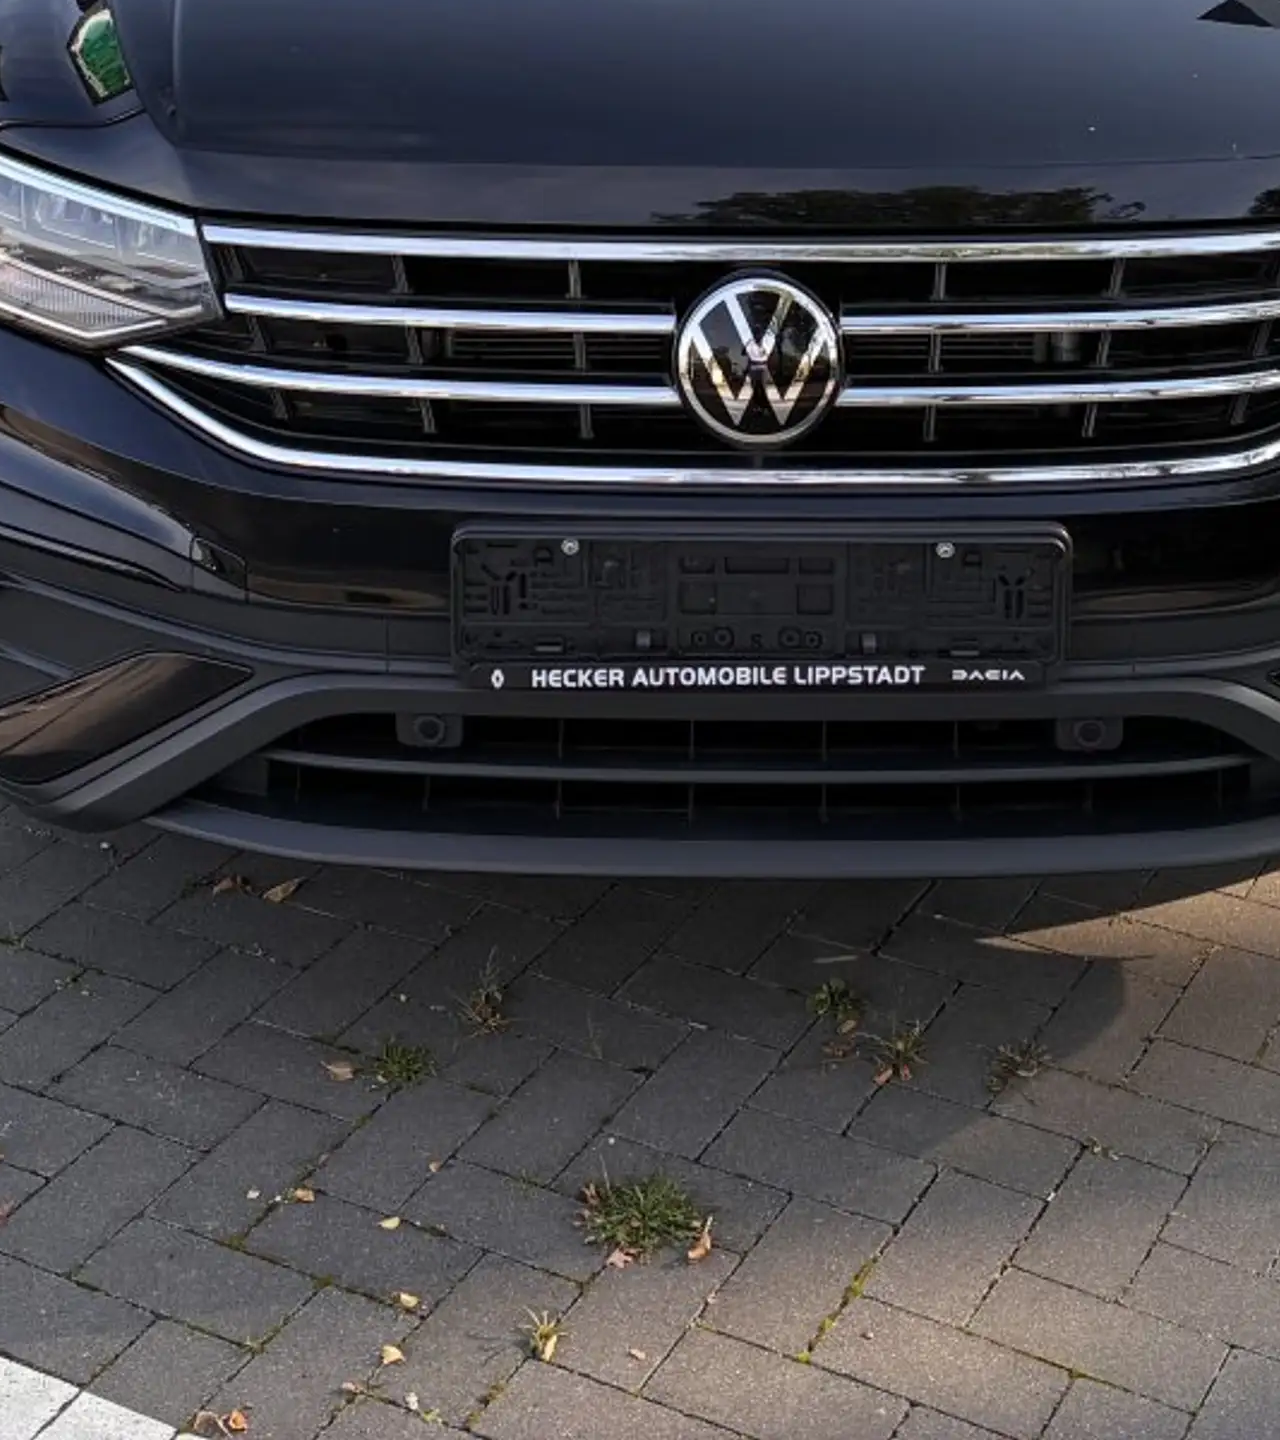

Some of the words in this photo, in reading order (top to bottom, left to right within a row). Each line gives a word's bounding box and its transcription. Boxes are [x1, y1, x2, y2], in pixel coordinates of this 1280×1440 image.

[531, 668, 625, 688] HECKER
[631, 666, 787, 687] AUTOMOBILE
[793, 664, 926, 686] LIPPSTADT
